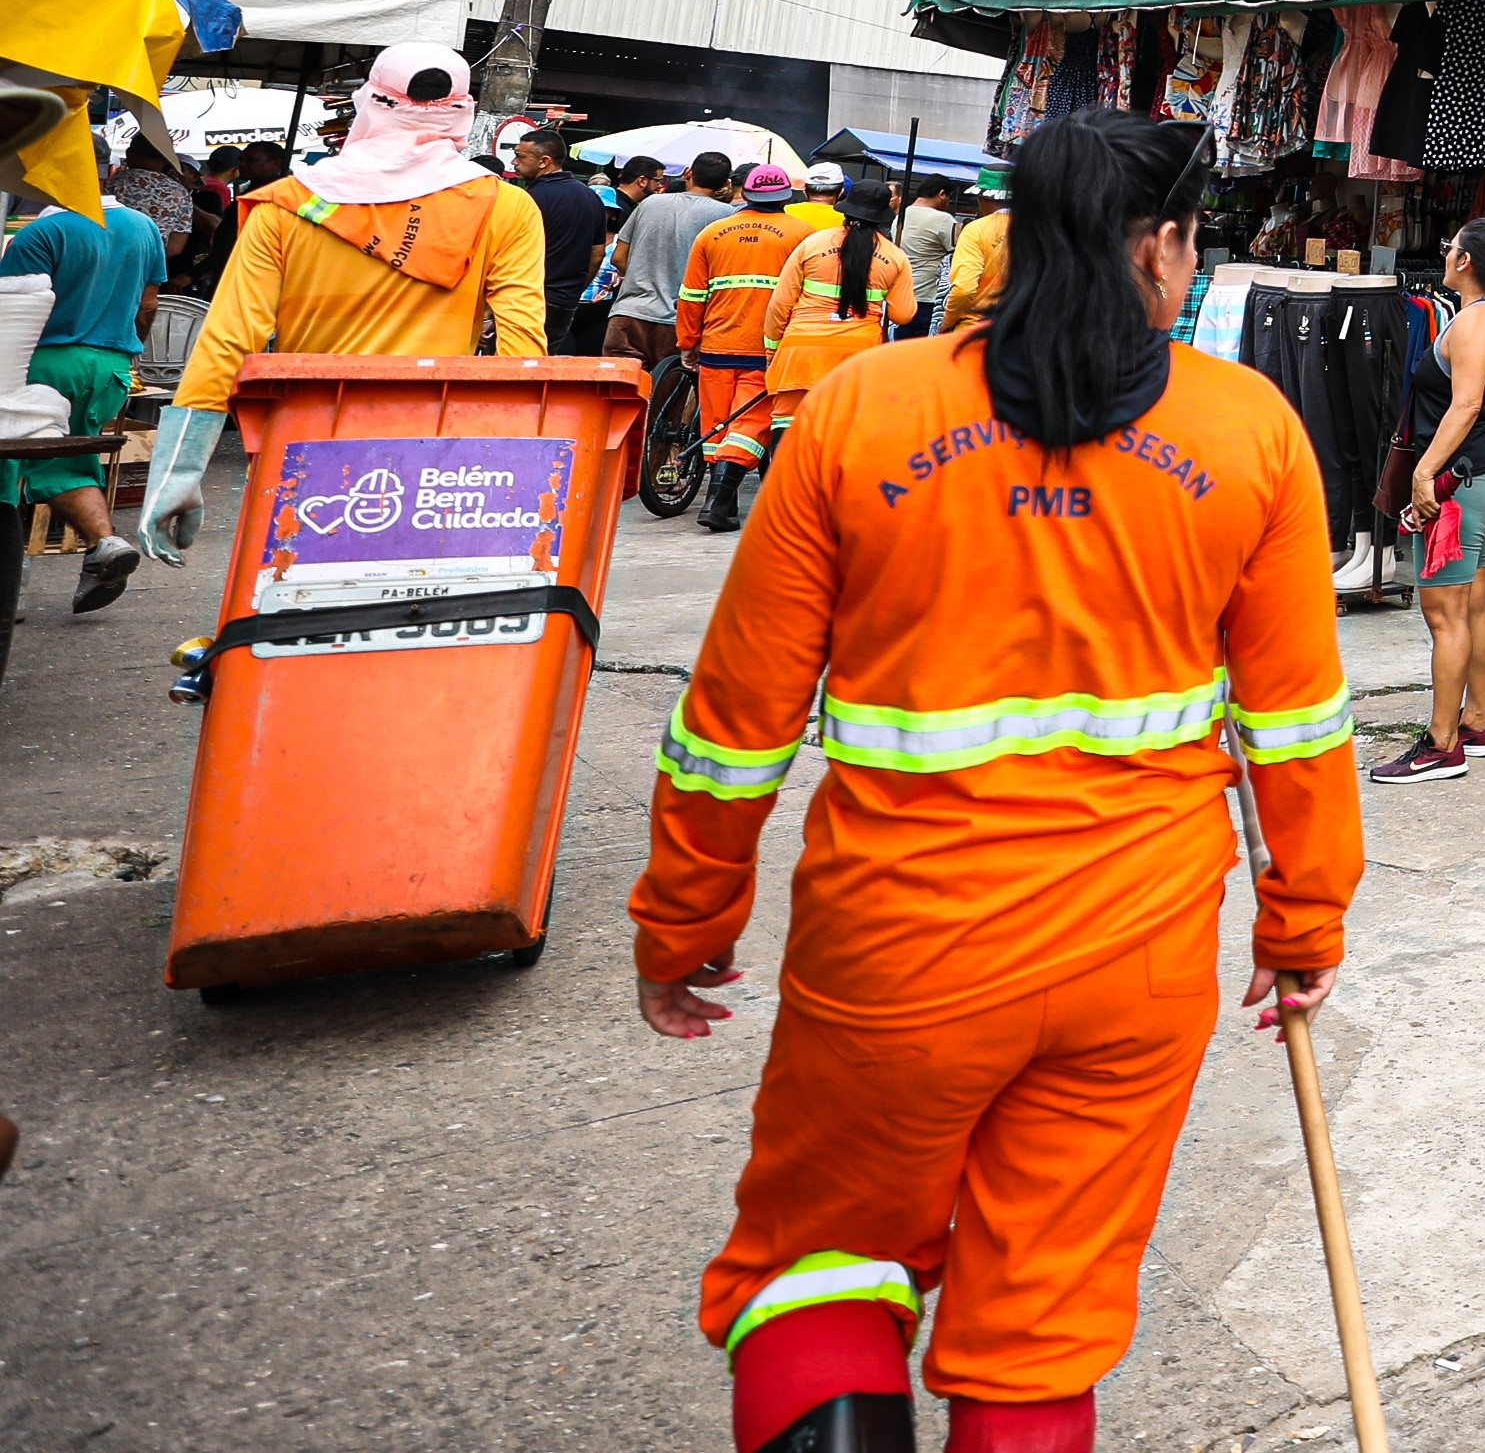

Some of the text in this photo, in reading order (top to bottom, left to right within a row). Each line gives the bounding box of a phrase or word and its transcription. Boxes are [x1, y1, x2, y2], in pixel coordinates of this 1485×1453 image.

[389, 203, 422, 268] A SERVIÇO
[718, 223, 750, 236] SERVIÇO
[763, 224, 785, 239] SESAN
[419, 464, 515, 487] Belém
[878, 479, 908, 508] A
[1114, 423, 1216, 501] SESAN
[415, 488, 485, 508] Bem
[1007, 485, 1093, 517] PMB
[411, 506, 540, 531] Cuidada
[437, 566, 489, 575] Prefeitura
